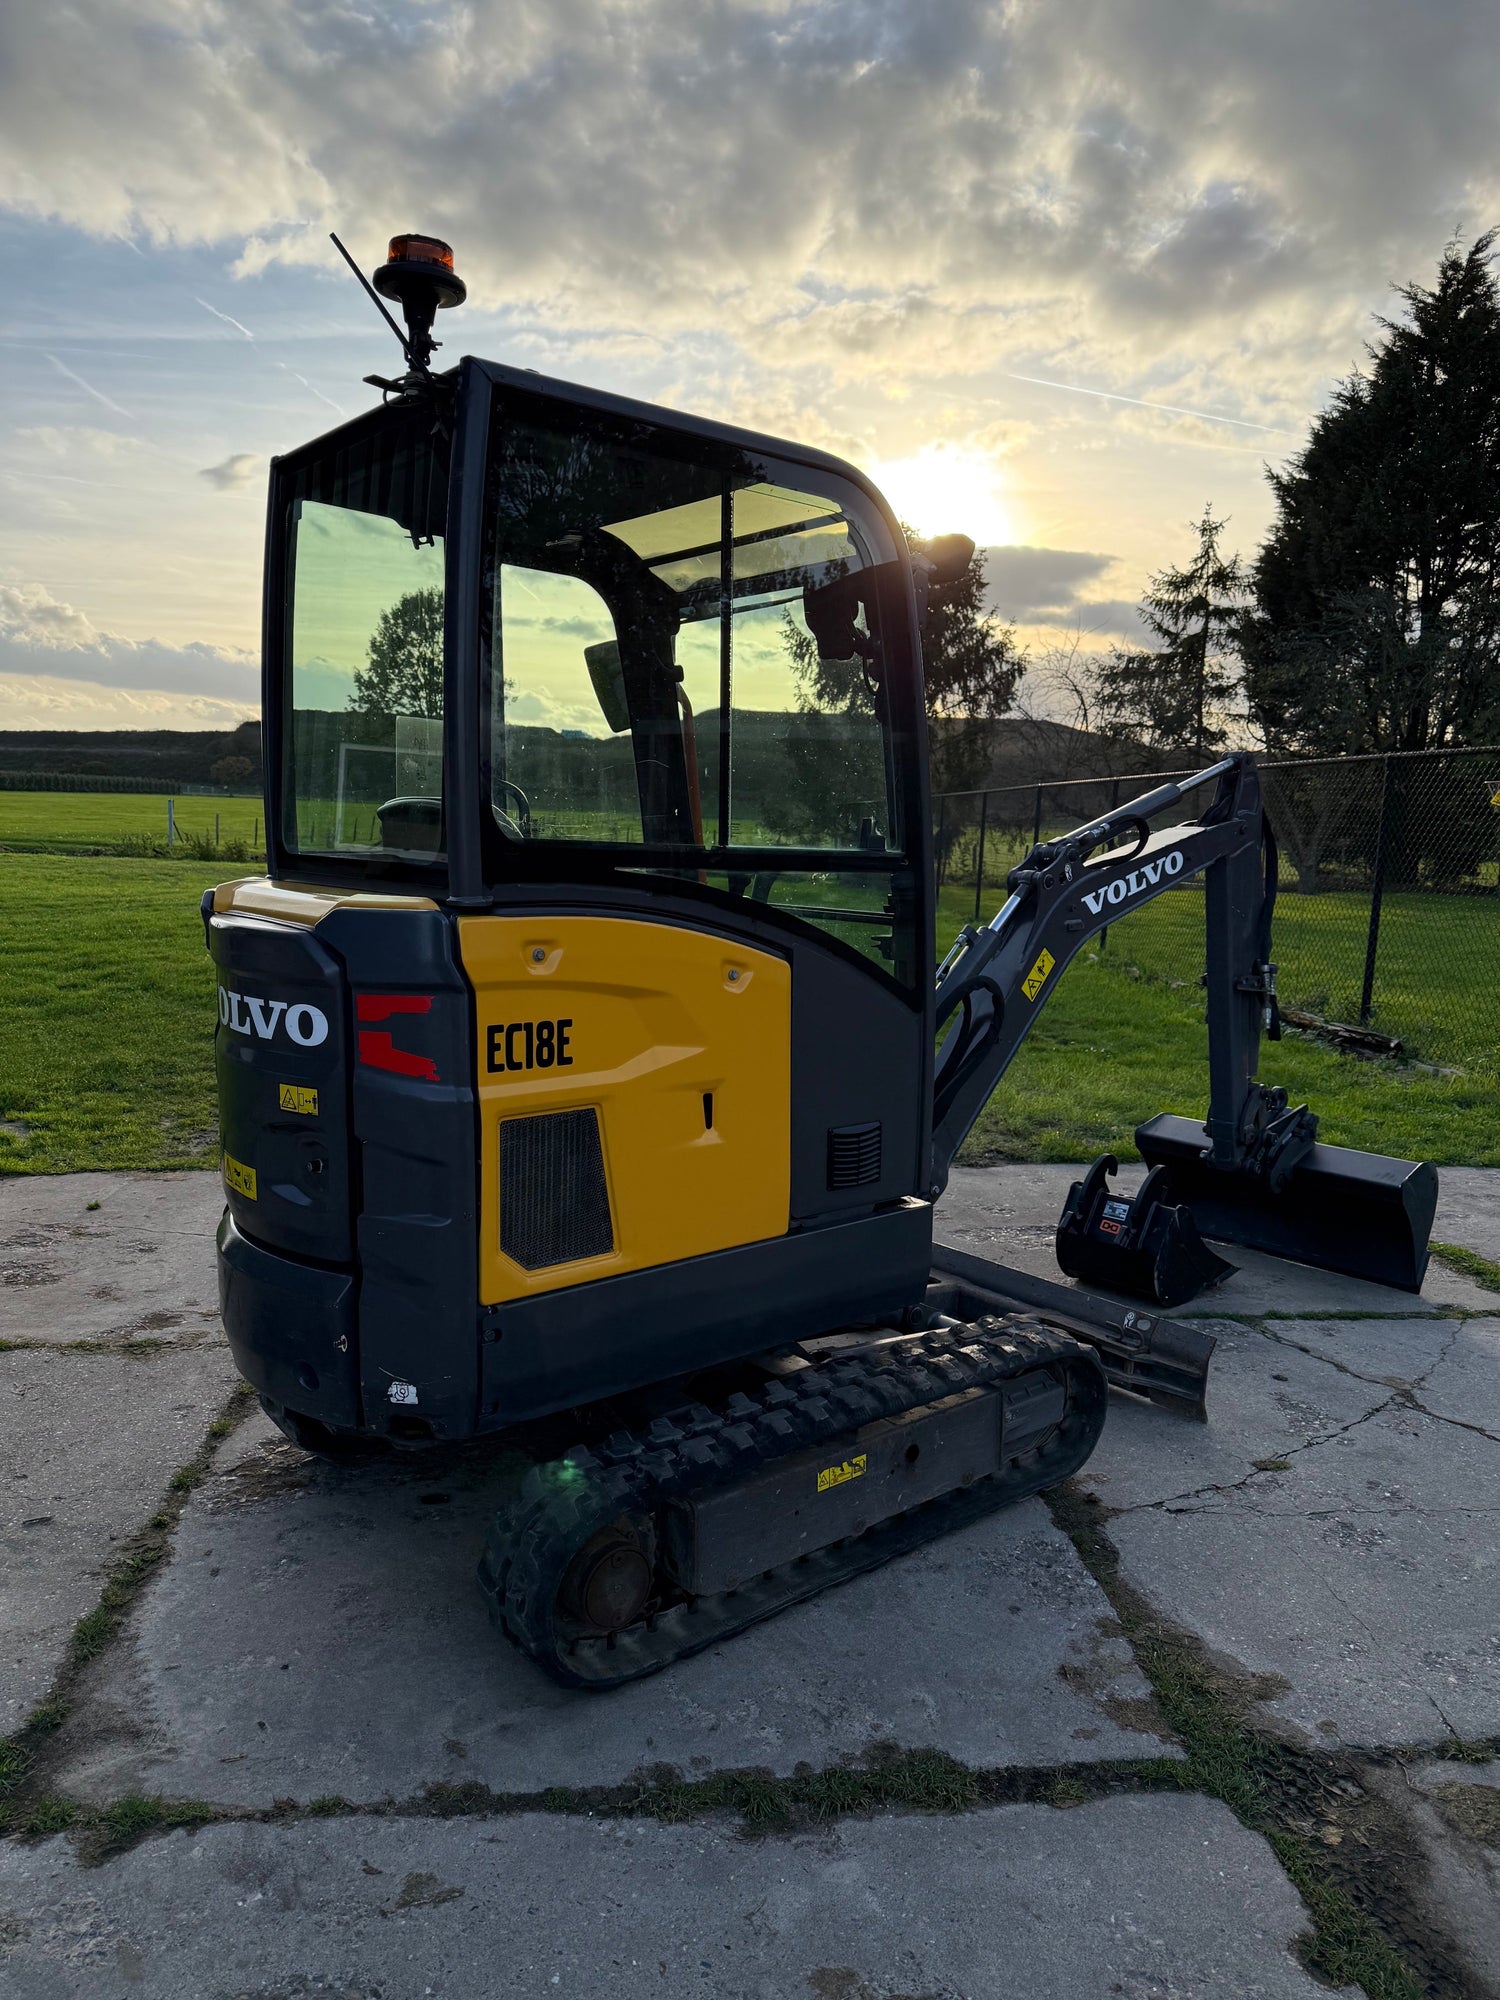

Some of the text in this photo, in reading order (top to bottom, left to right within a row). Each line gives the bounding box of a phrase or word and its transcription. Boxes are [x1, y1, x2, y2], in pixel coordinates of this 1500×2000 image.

[1081, 851, 1184, 915] VOLVO
[218, 985, 329, 1047] OLVO
[487, 1019, 573, 1073] EC18E
